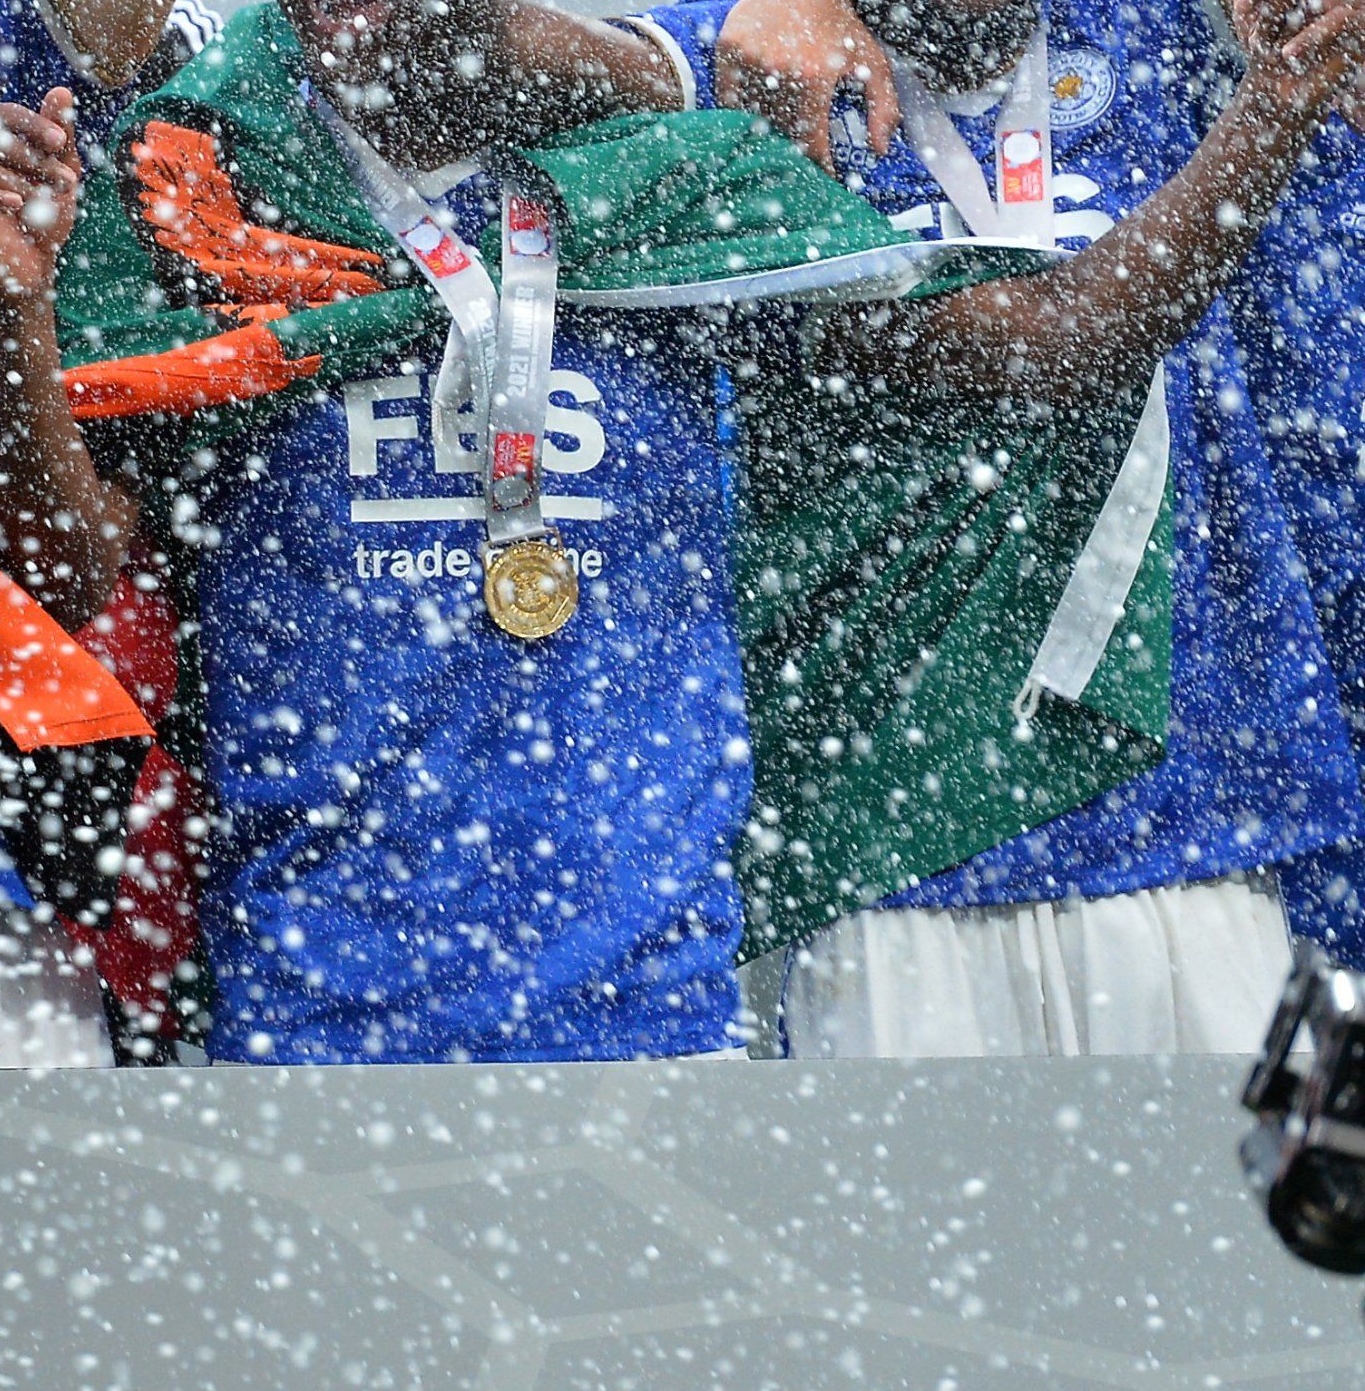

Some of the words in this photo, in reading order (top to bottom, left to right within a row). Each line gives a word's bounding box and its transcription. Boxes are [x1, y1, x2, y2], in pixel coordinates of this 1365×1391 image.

[509, 286, 534, 351] WINNER
[505, 354, 529, 398] 2021
[354, 541, 470, 579] trade
